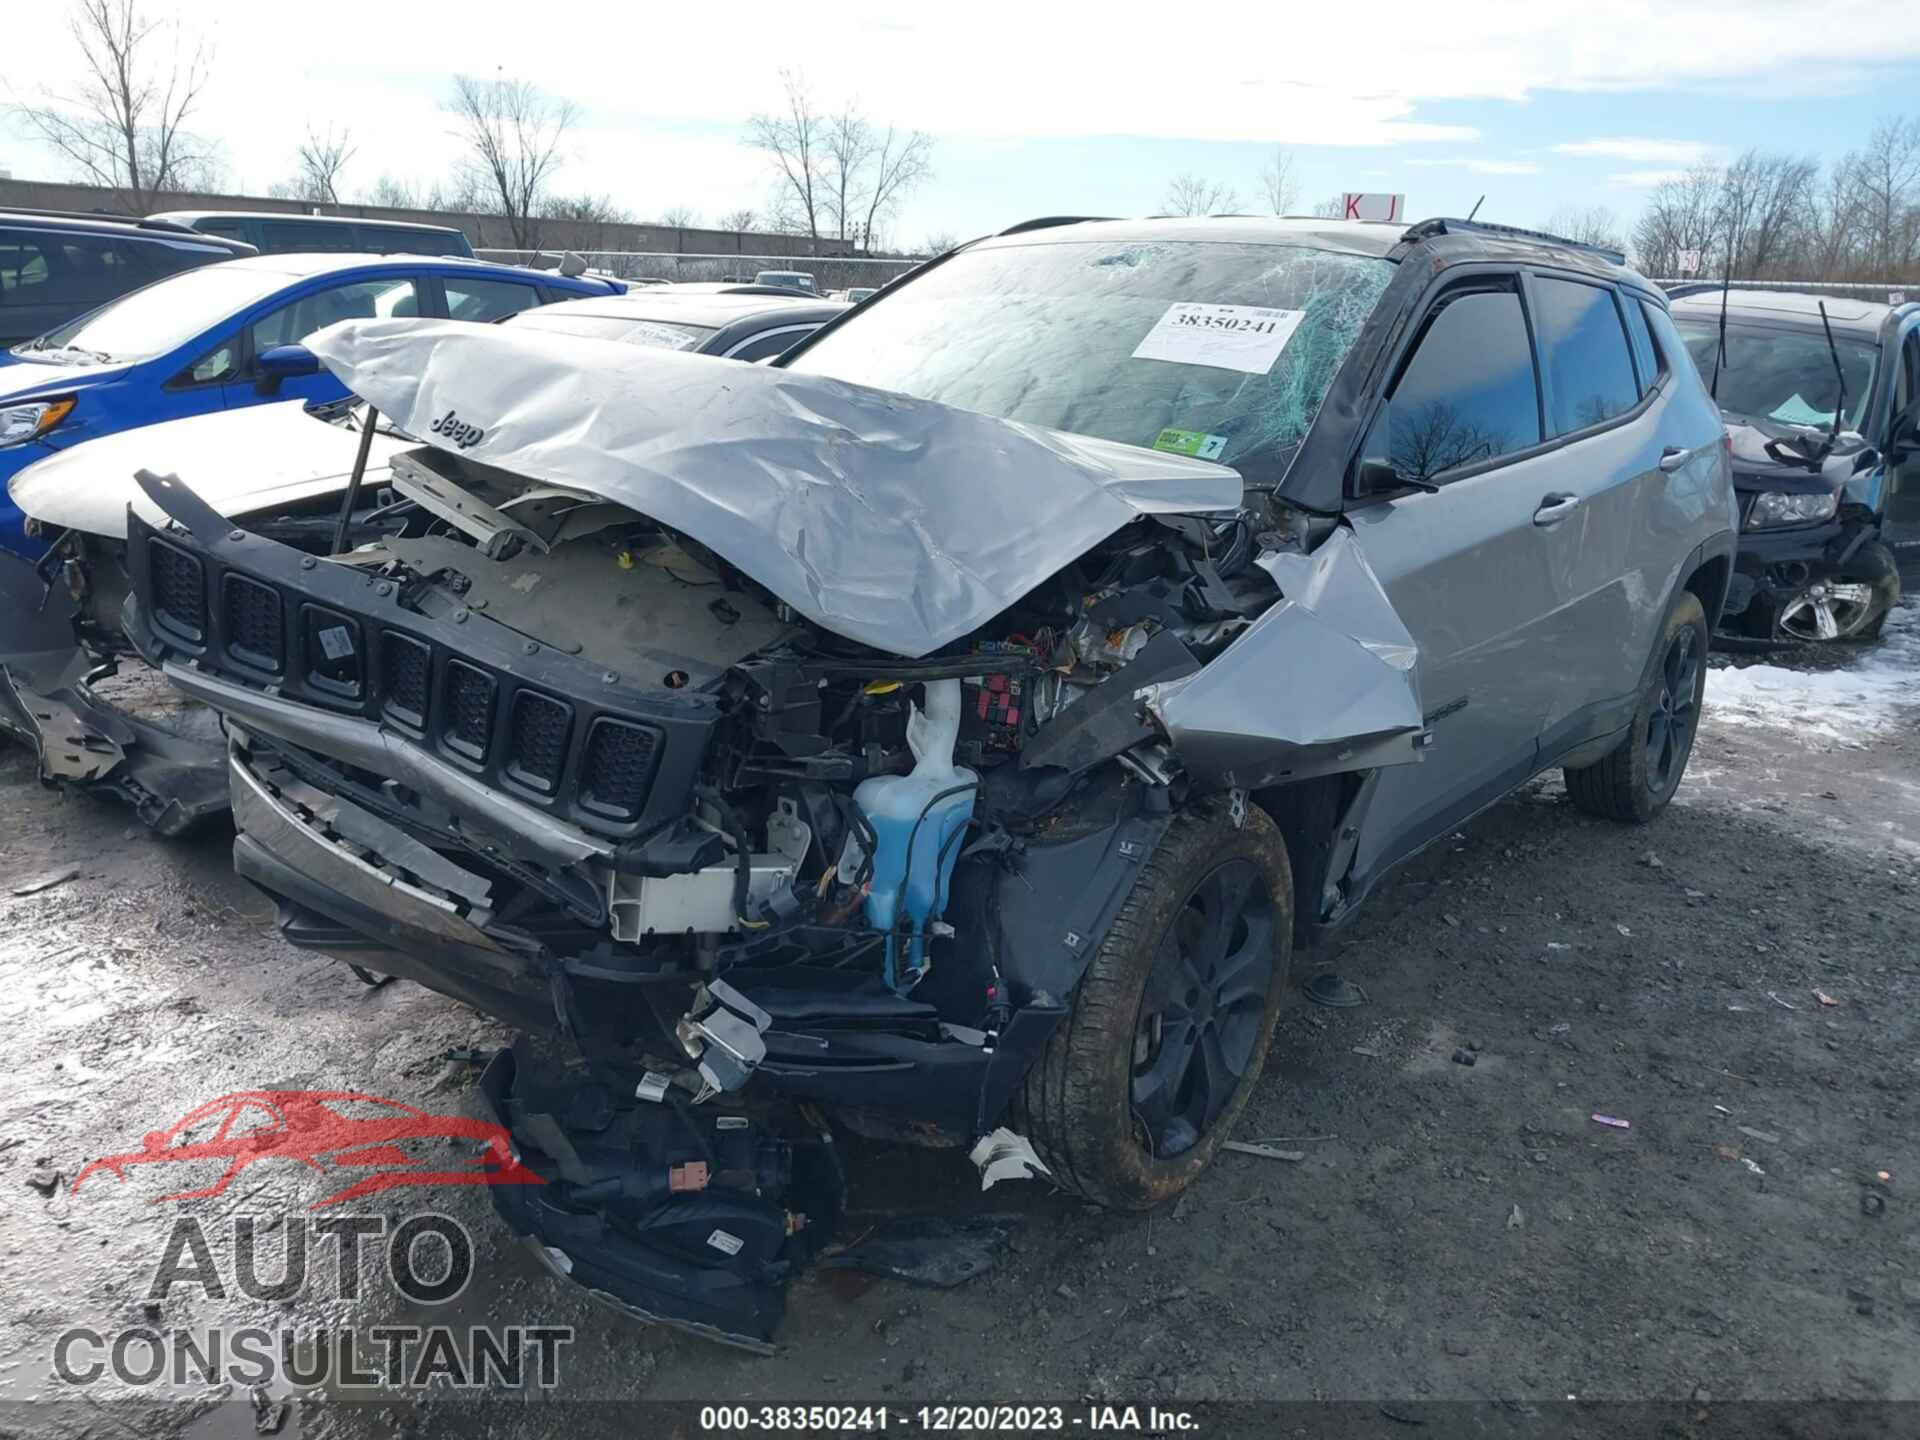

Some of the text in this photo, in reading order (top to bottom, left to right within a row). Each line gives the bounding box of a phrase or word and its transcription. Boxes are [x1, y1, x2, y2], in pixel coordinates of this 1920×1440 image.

[1345, 194, 1362, 219] K
[1171, 313, 1277, 334] 38350241
[431, 410, 485, 449] Jeep
